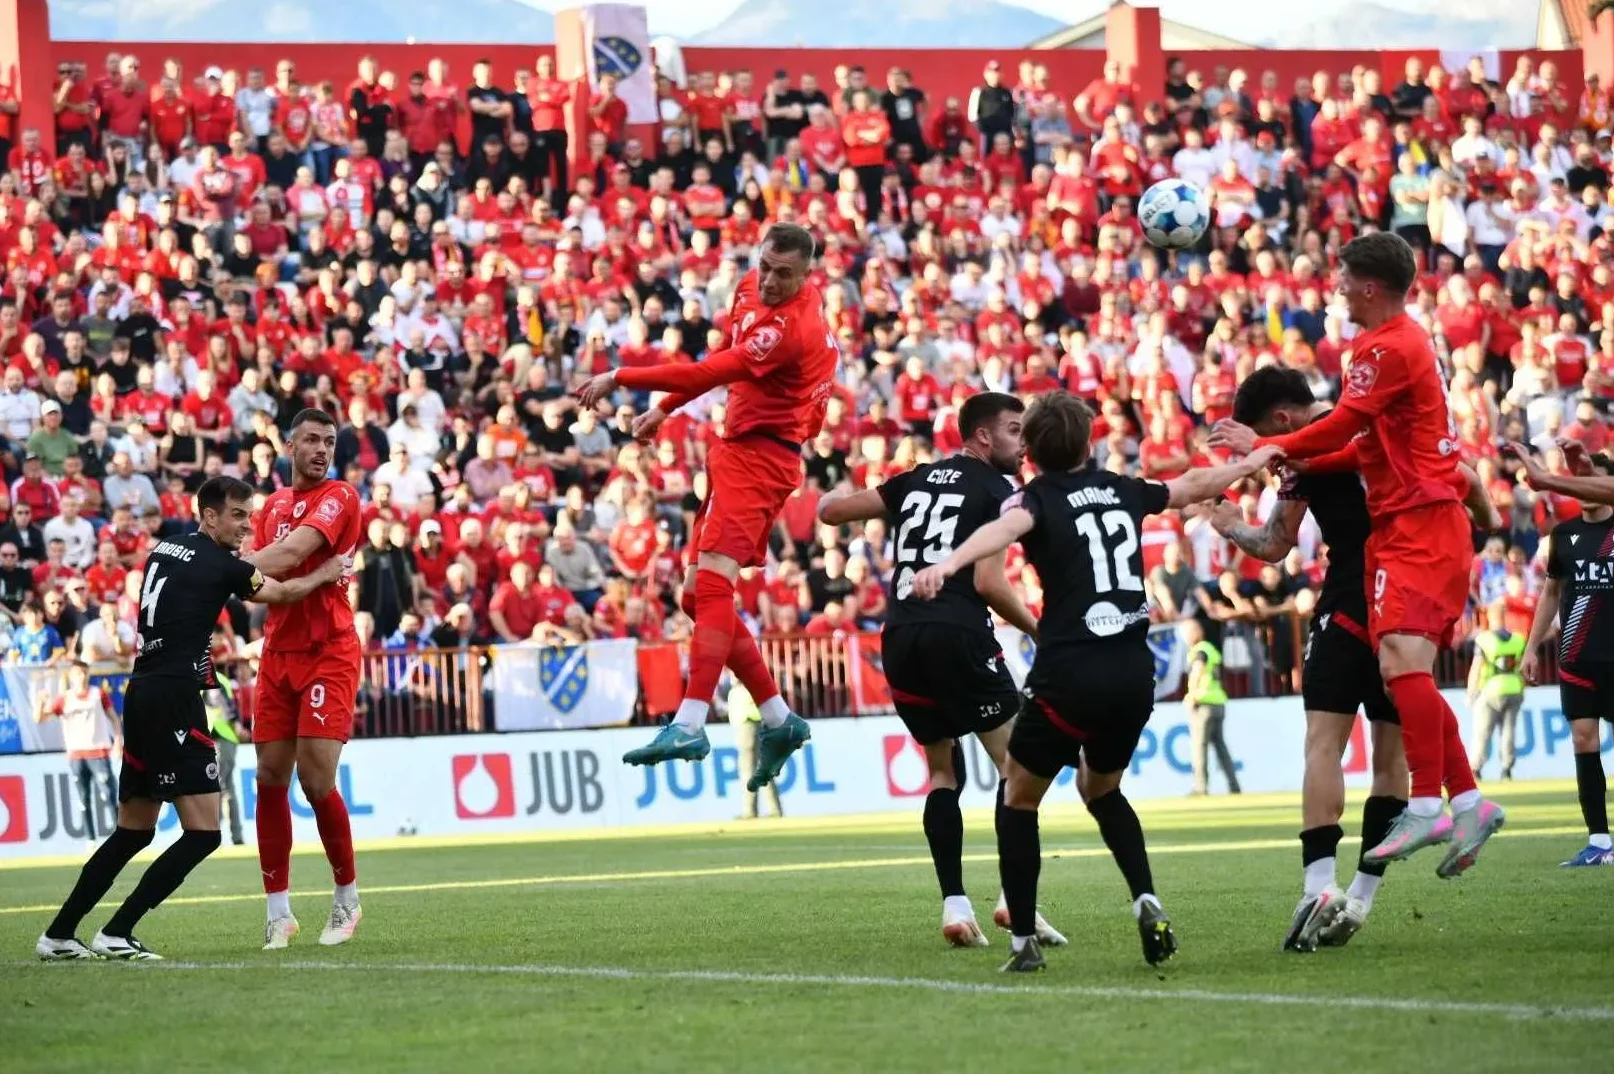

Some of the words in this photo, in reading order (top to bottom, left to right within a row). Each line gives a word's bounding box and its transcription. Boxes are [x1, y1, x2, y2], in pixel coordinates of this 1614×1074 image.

[898, 490, 966, 565] 25
[1074, 509, 1144, 593] 12
[140, 562, 168, 628] 4
[1374, 569, 1387, 599] 9
[310, 684, 325, 708] 9
[526, 749, 604, 815] JUB
